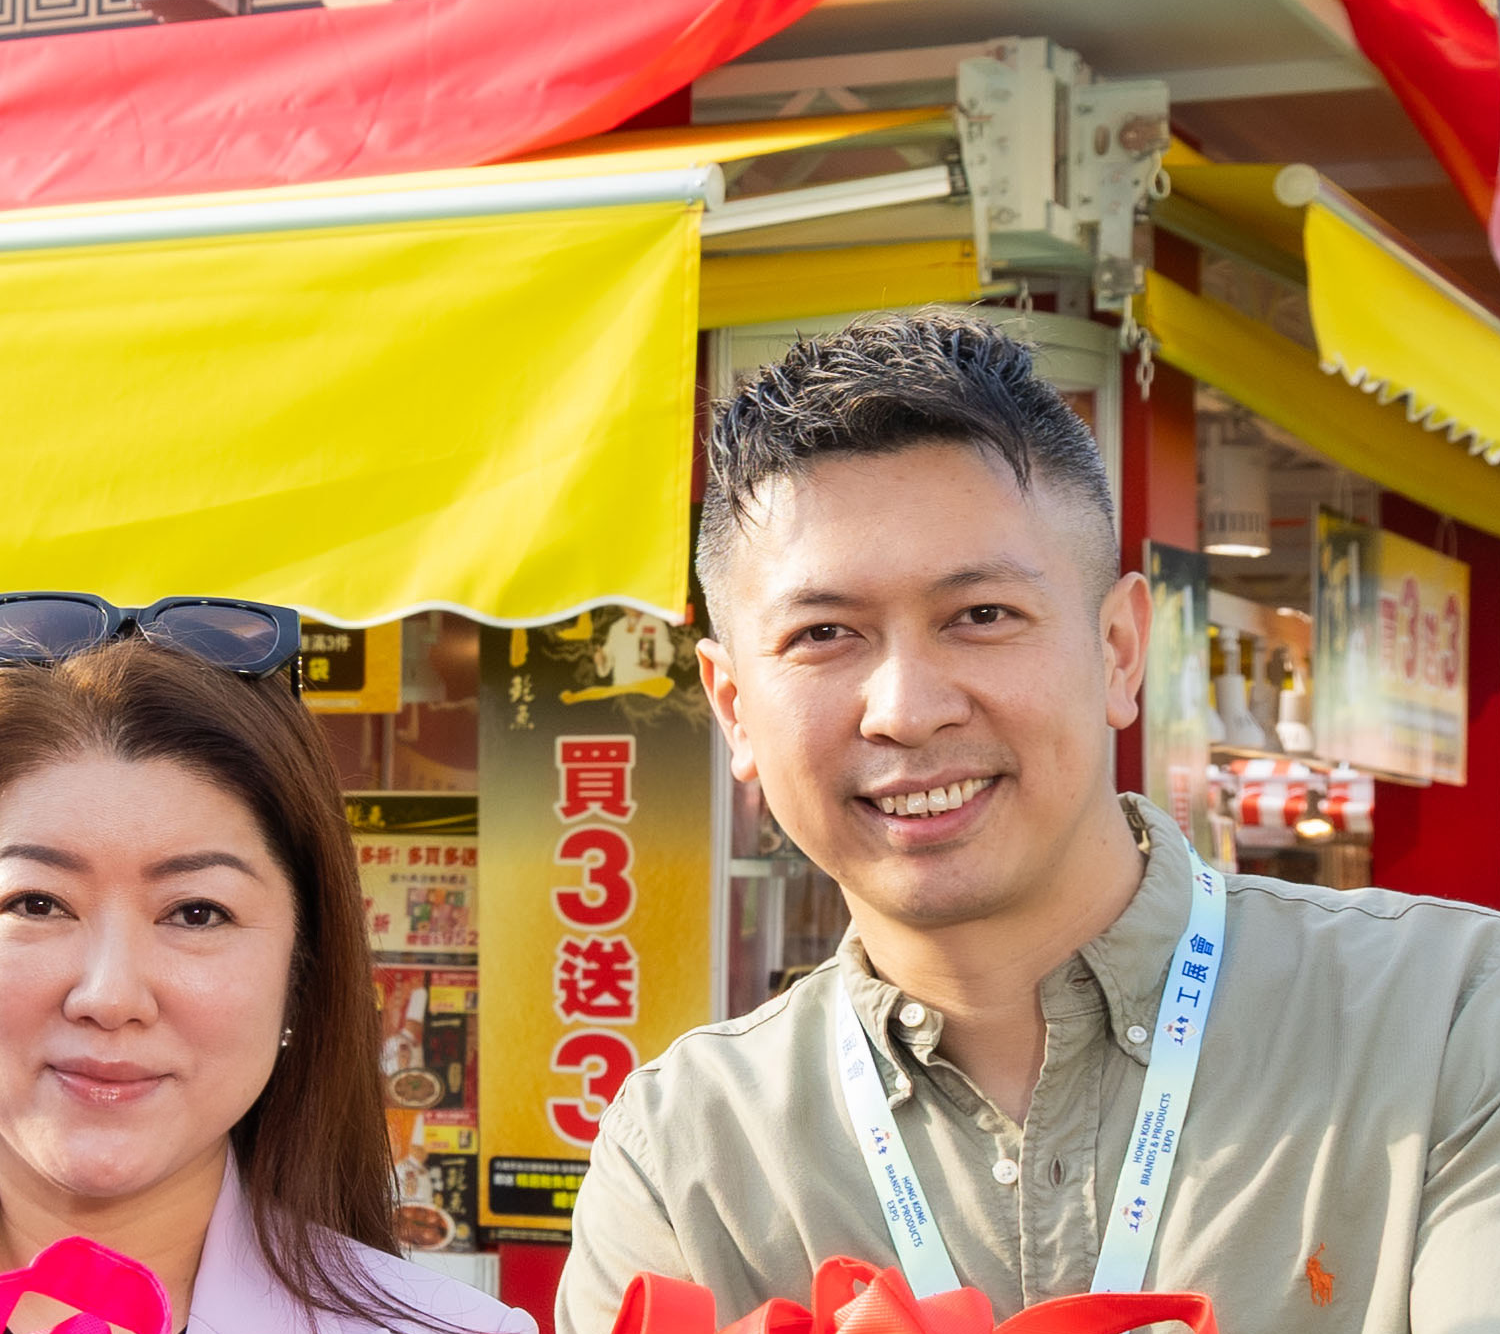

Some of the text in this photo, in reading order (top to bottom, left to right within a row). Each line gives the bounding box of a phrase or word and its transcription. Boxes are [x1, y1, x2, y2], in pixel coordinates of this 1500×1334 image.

[548, 735, 638, 1147] 買3送3
[1176, 932, 1215, 1008] 工展會
[1133, 1110, 1154, 1163] HONG KONG
[1140, 1092, 1171, 1186] BRANDS & PRODUCTS
[1161, 1129, 1175, 1153] EXPO
[885, 1164, 903, 1197] BRANDS
[902, 1204, 924, 1248] PRODUCTS
[886, 1200, 900, 1222] EXPO
[903, 1176, 928, 1225] HONG KONG
